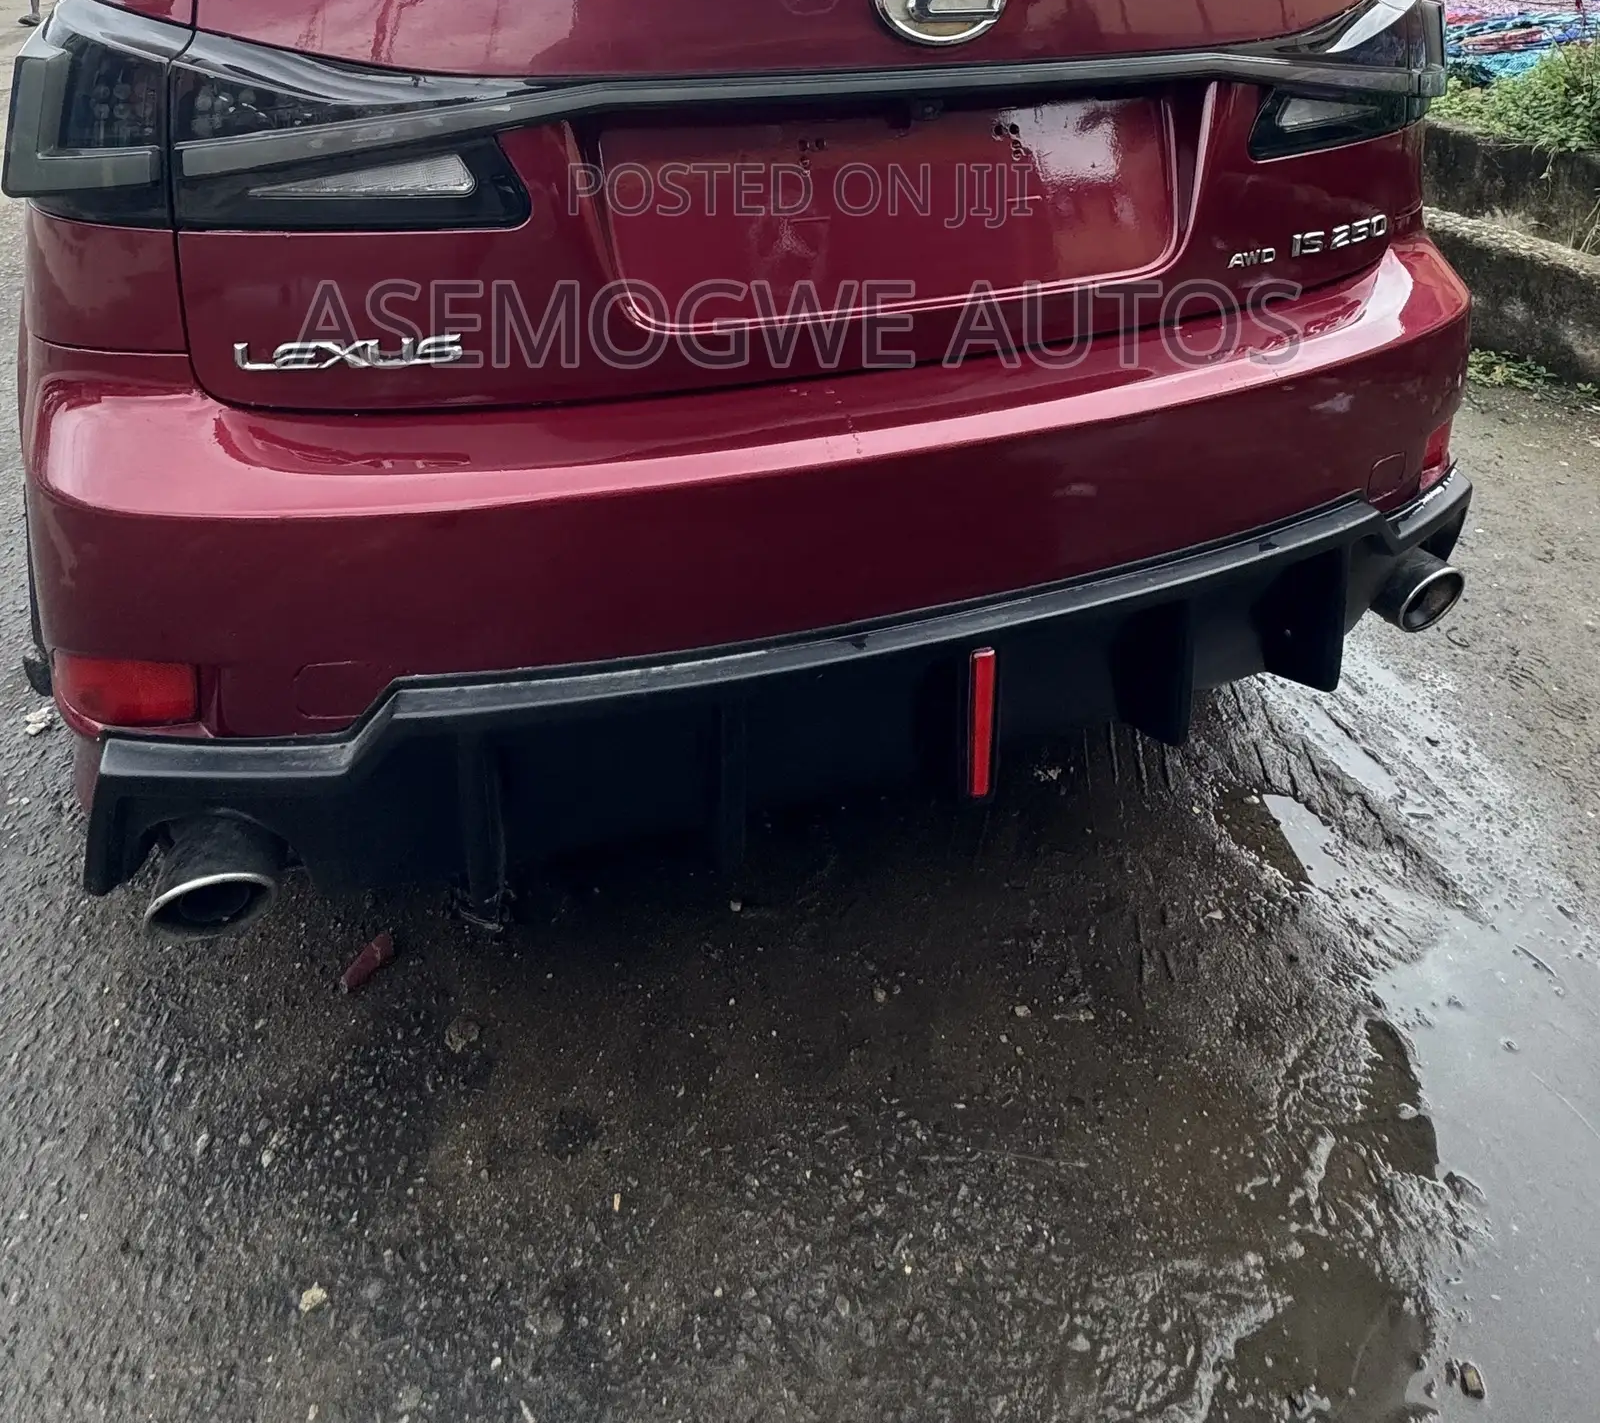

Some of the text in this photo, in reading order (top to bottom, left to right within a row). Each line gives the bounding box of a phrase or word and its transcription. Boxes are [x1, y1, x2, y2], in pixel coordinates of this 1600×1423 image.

[1291, 213, 1389, 259] IS 250
[1227, 246, 1276, 270] AWD
[233, 333, 463, 372] LEXUS
